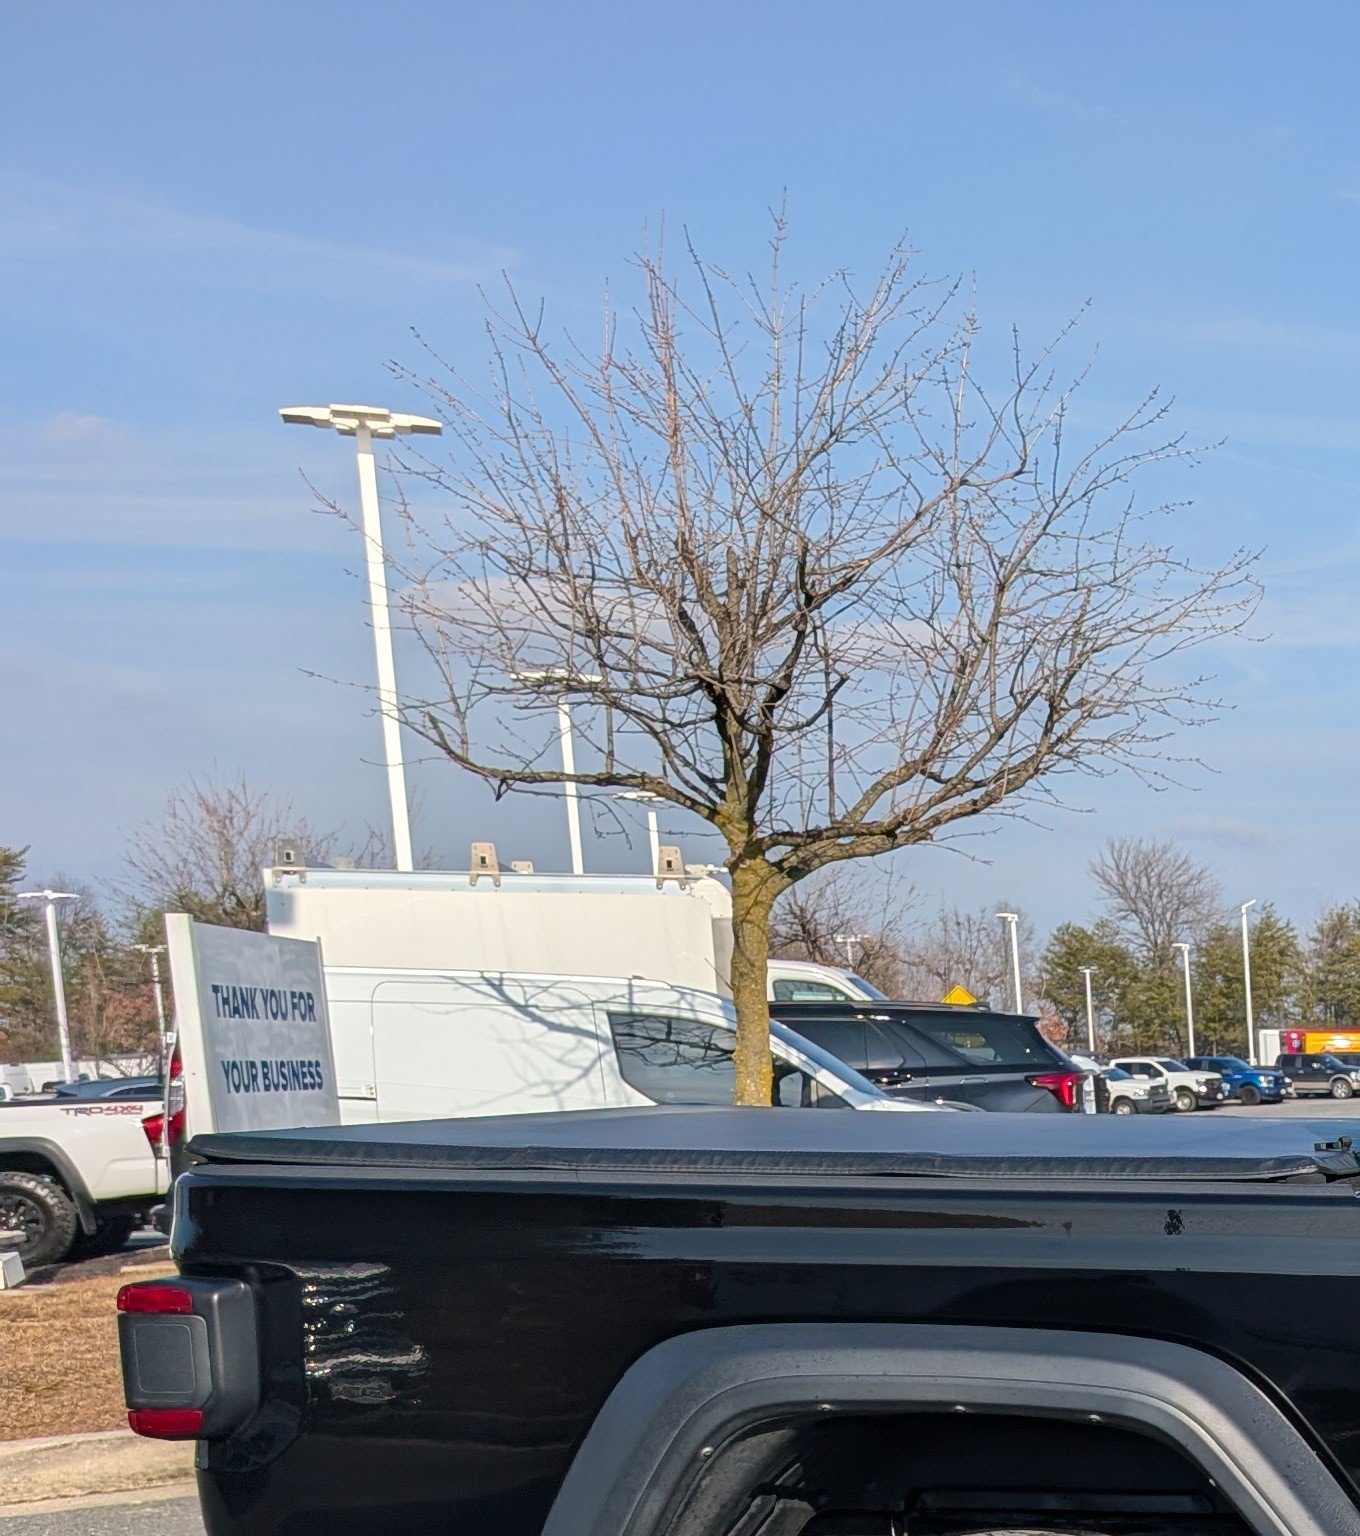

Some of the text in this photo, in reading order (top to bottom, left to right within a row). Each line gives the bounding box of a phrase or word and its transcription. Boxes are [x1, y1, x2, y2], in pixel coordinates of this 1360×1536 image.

[211, 984, 317, 1022] THANK YOU FOR
[221, 1059, 323, 1094] YOUR BUSINESS
